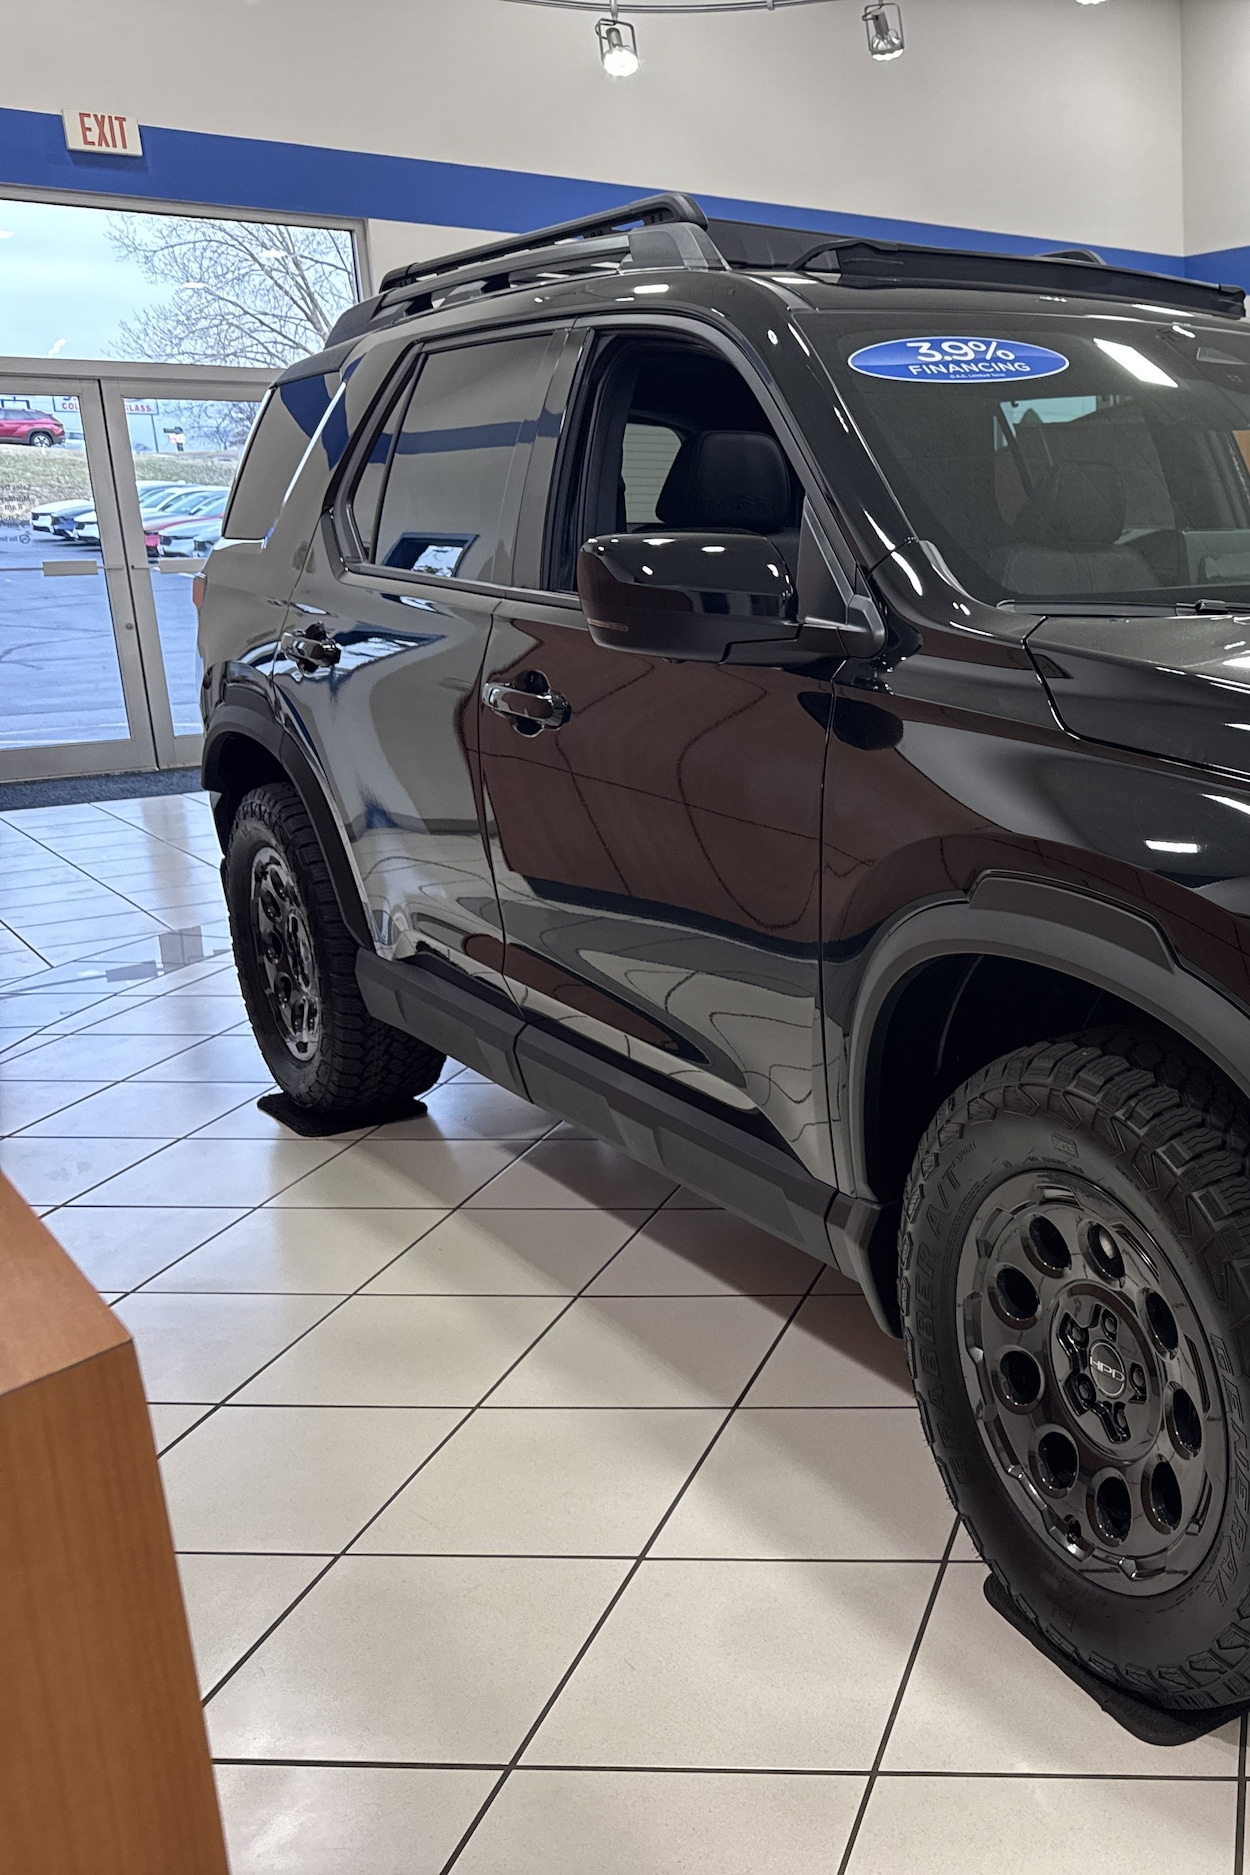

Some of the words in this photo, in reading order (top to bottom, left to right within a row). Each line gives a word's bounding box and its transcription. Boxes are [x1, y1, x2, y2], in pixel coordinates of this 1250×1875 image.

[79, 112, 127, 150] EXIT
[906, 341, 1016, 362] 3.9%
[908, 361, 1031, 375] FINANCING
[125, 404, 152, 412] LASS
[1090, 1356, 1126, 1382] HPD
[1207, 1332, 1250, 1608] GENERAL
